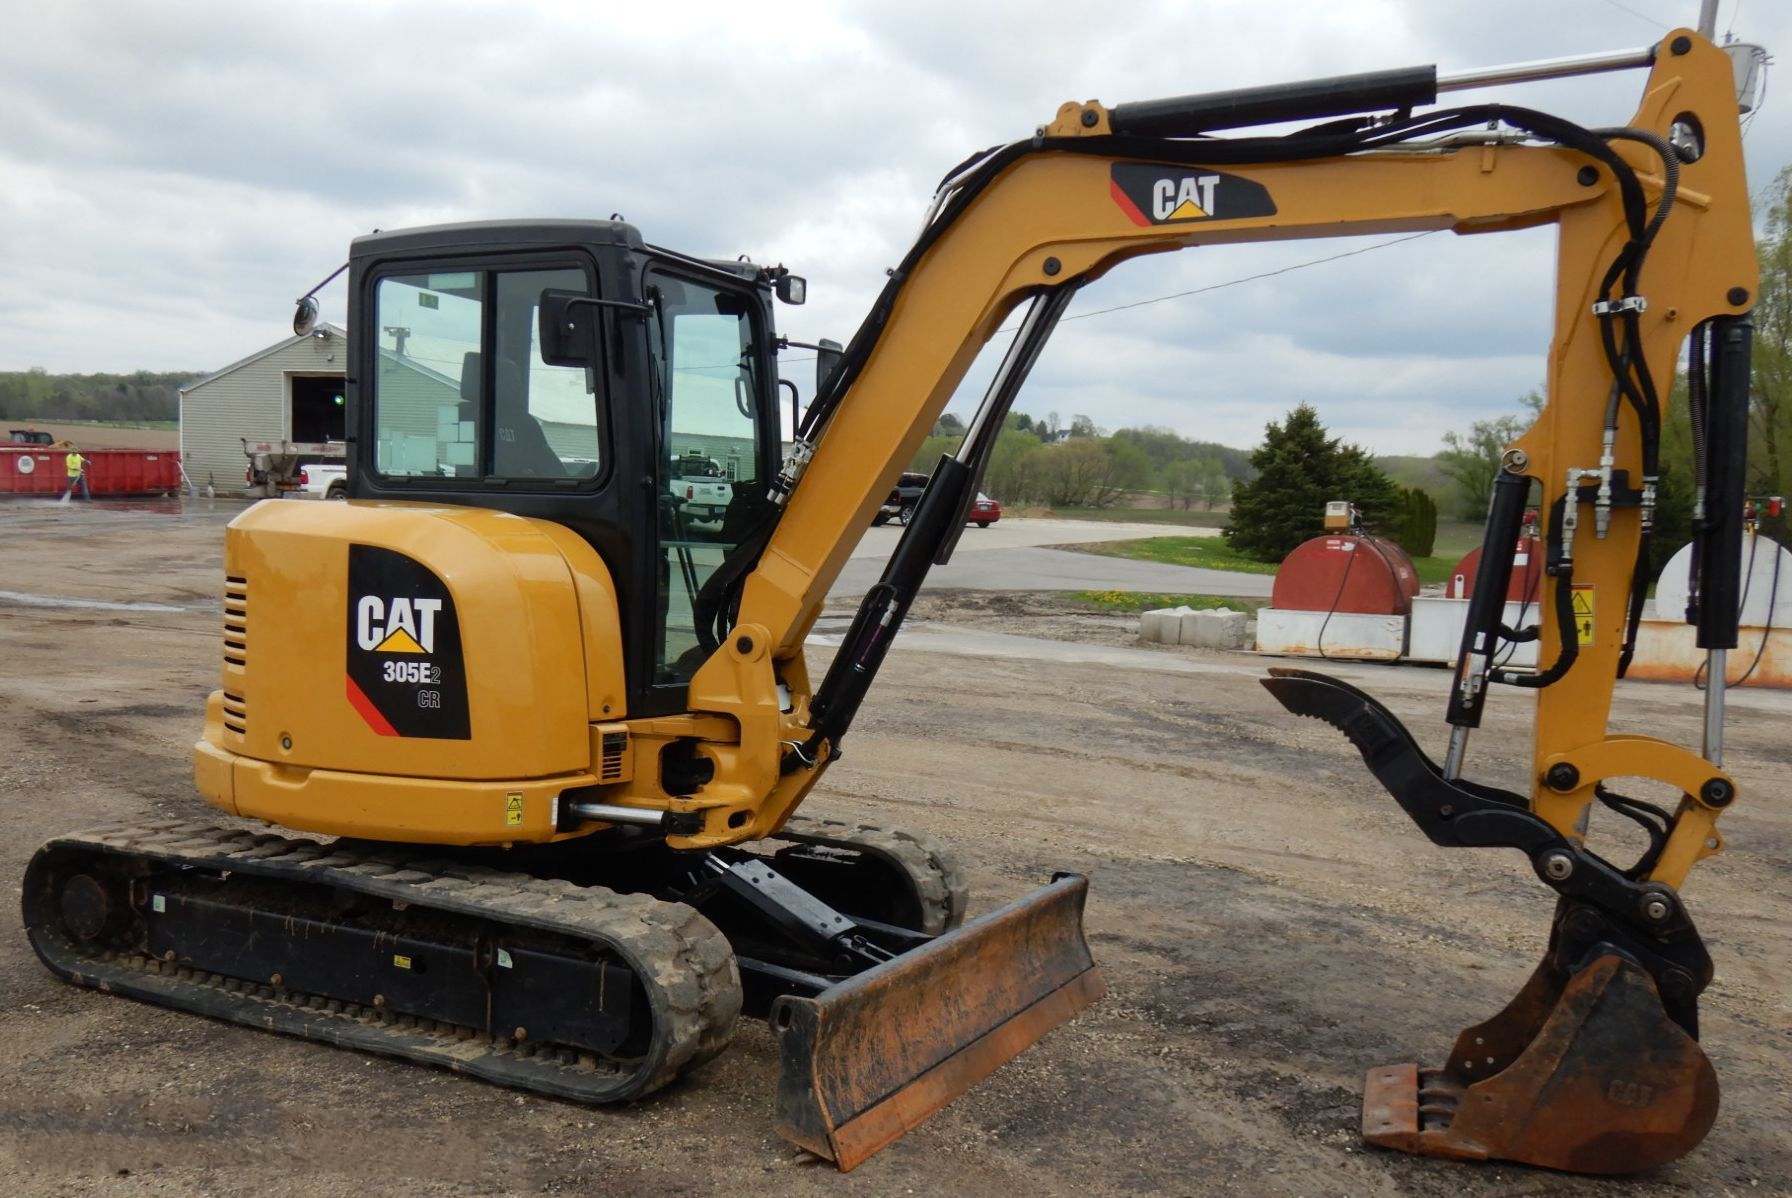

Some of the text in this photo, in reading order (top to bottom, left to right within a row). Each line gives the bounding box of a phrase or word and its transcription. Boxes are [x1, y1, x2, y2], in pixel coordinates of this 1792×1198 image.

[1152, 175, 1220, 220] CAT
[357, 595, 442, 654] CAT
[418, 689, 441, 708] CR
